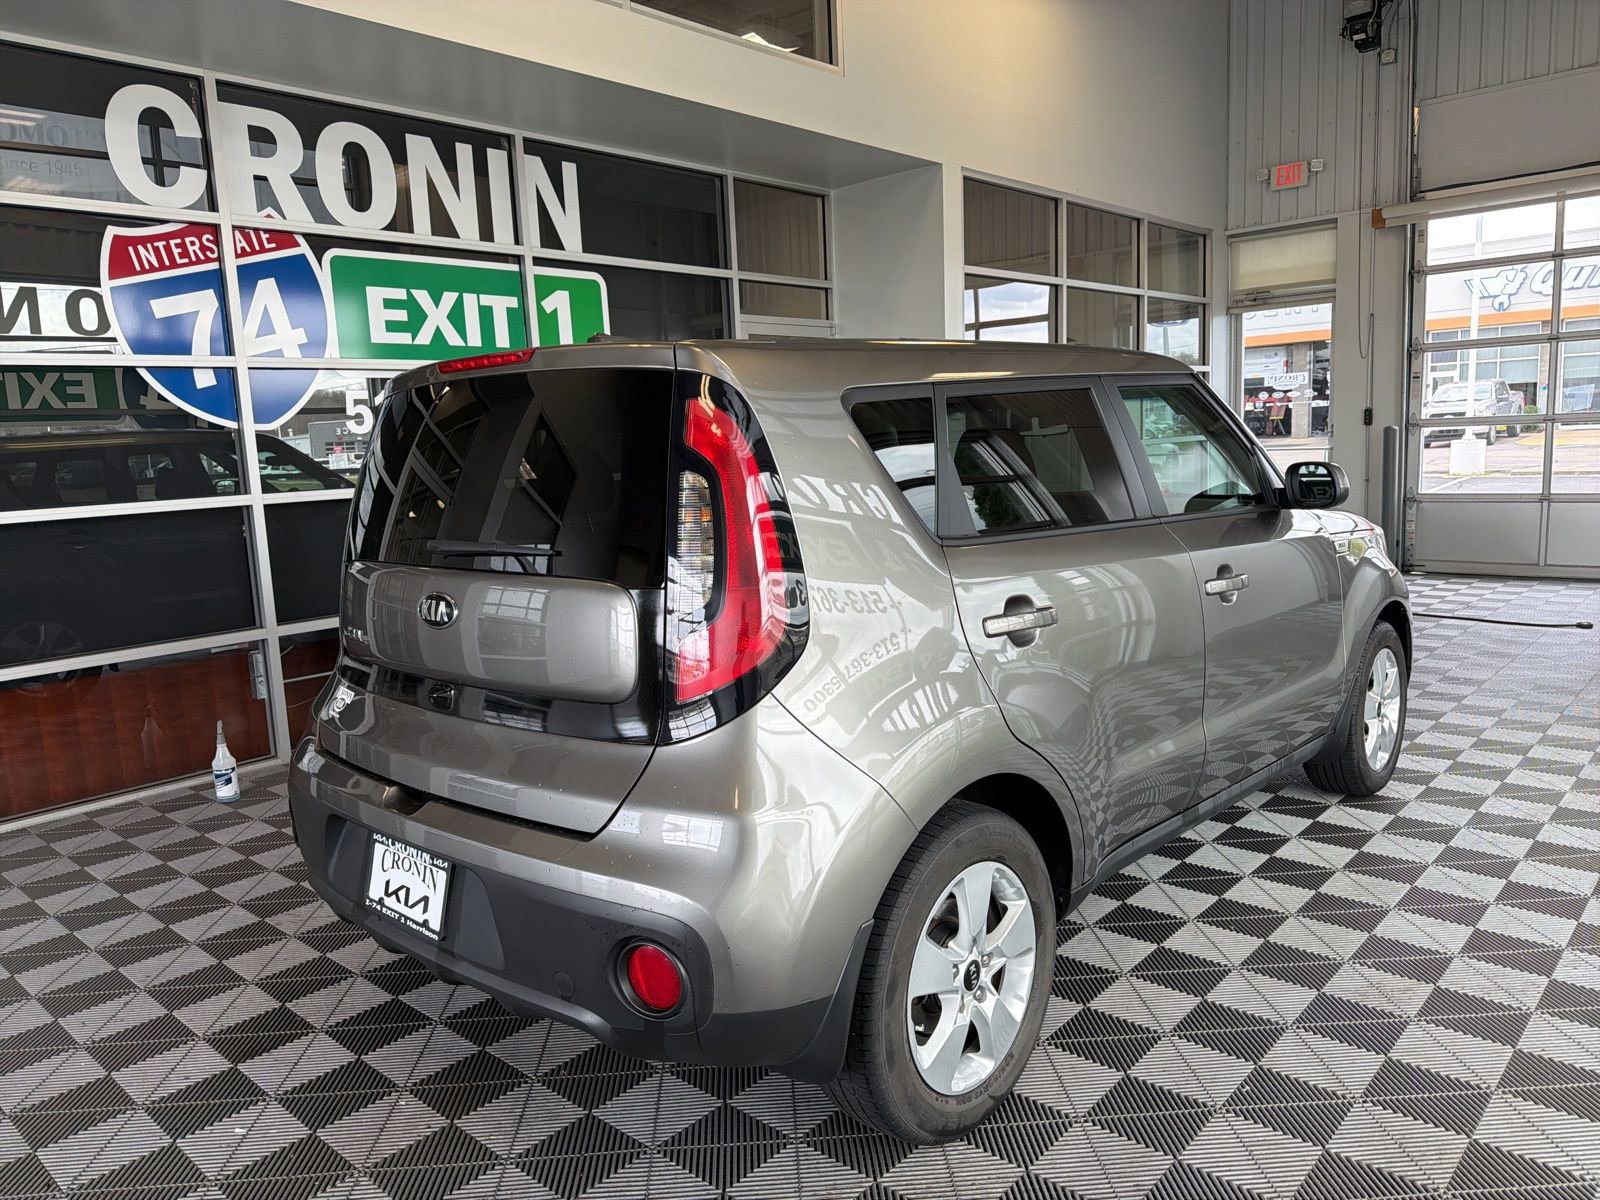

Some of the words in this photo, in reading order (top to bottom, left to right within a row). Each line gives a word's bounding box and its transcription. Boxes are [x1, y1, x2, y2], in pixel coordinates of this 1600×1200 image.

[104, 84, 583, 253] CRONIN
[1275, 161, 1303, 187] EXIT
[128, 229, 277, 271] INTERSATE
[149, 277, 308, 389] 74
[365, 286, 518, 348] EXIT
[540, 290, 574, 346] 1
[420, 598, 451, 623] KIA
[388, 838, 430, 864] CRONIN
[381, 848, 440, 895] CRONIN
[384, 878, 430, 915] KIA
[382, 907, 399, 920] EXIT
[406, 919, 439, 941] Harrison
[969, 962, 978, 989] KIA
